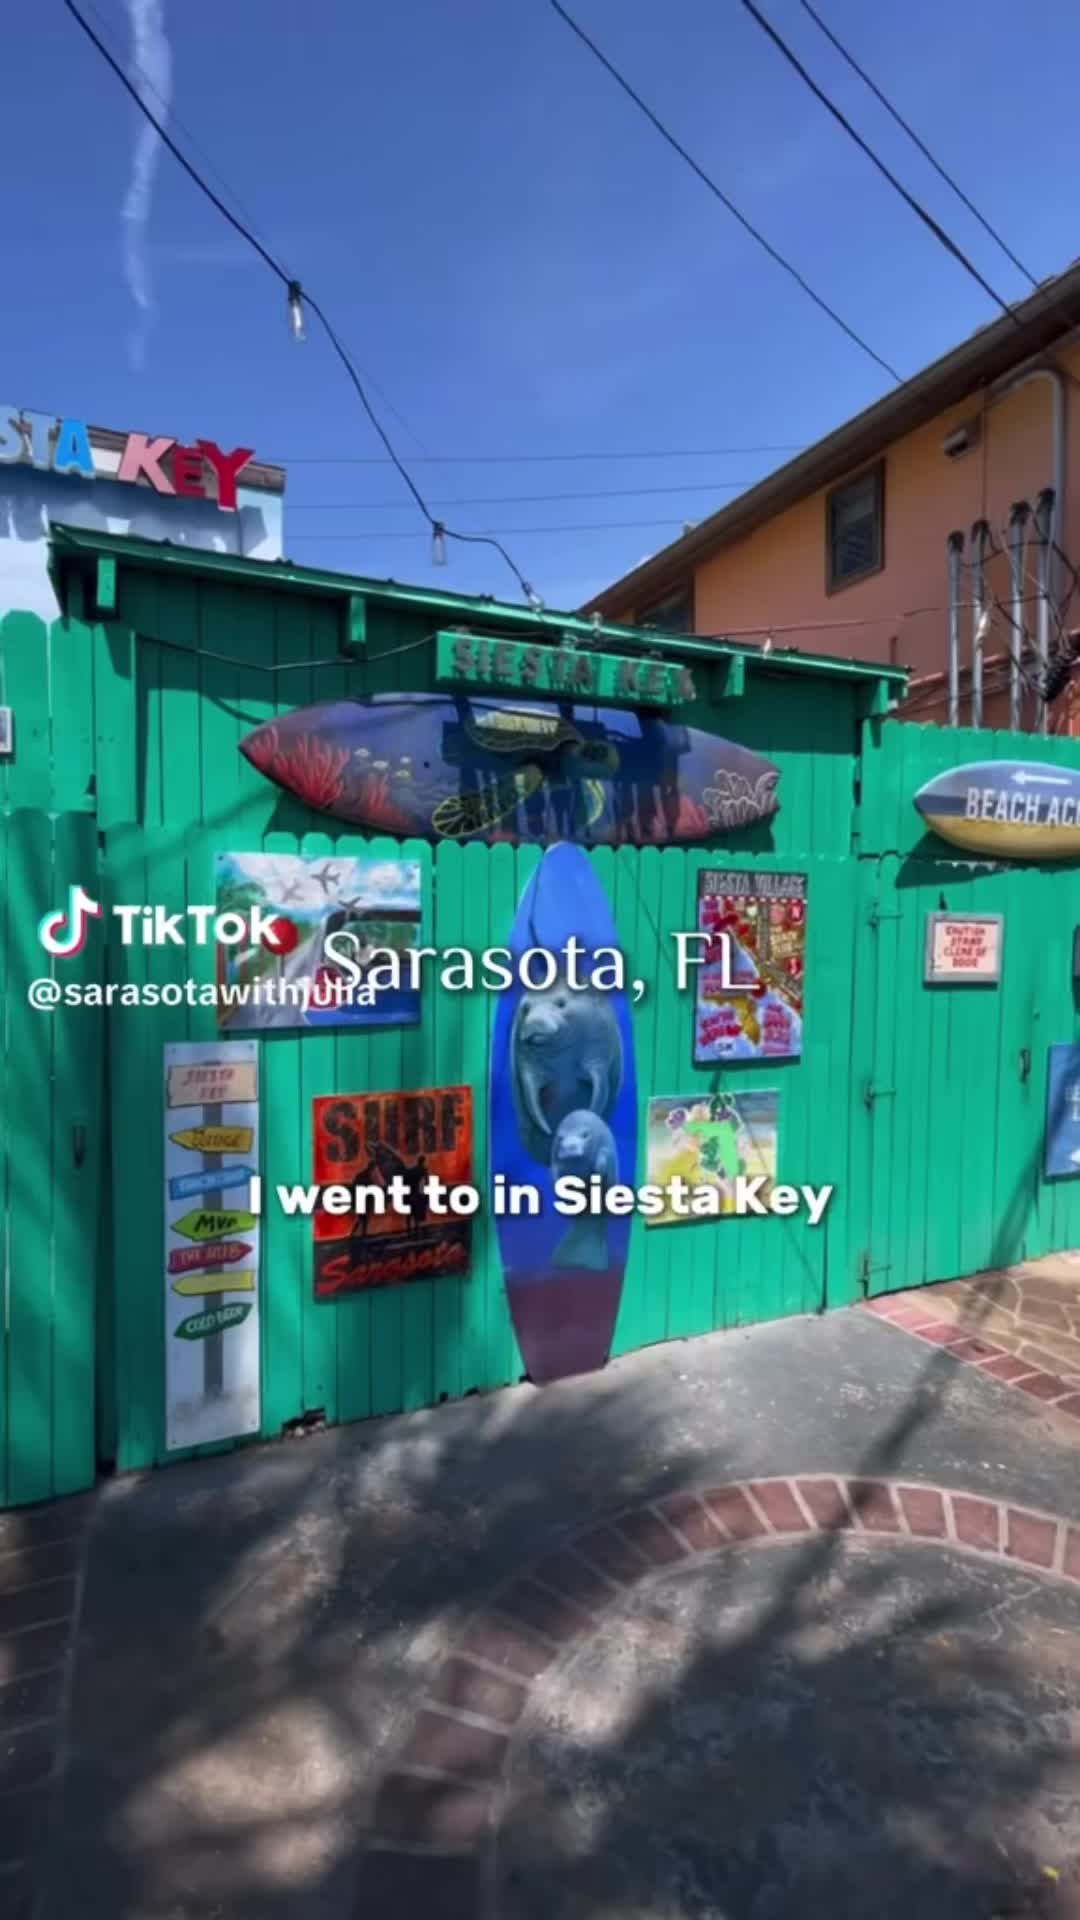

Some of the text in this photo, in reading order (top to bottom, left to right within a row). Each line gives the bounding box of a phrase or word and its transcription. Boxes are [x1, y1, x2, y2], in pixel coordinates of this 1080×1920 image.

[118, 430, 253, 512] KEY
[454, 634, 592, 694] SIESTA
[965, 787, 1040, 826] BEACH
[704, 871, 750, 895] SIESTA
[324, 1093, 465, 1164] SURF
[194, 1213, 239, 1233] MVP
[316, 1241, 466, 1296] Sarasota
